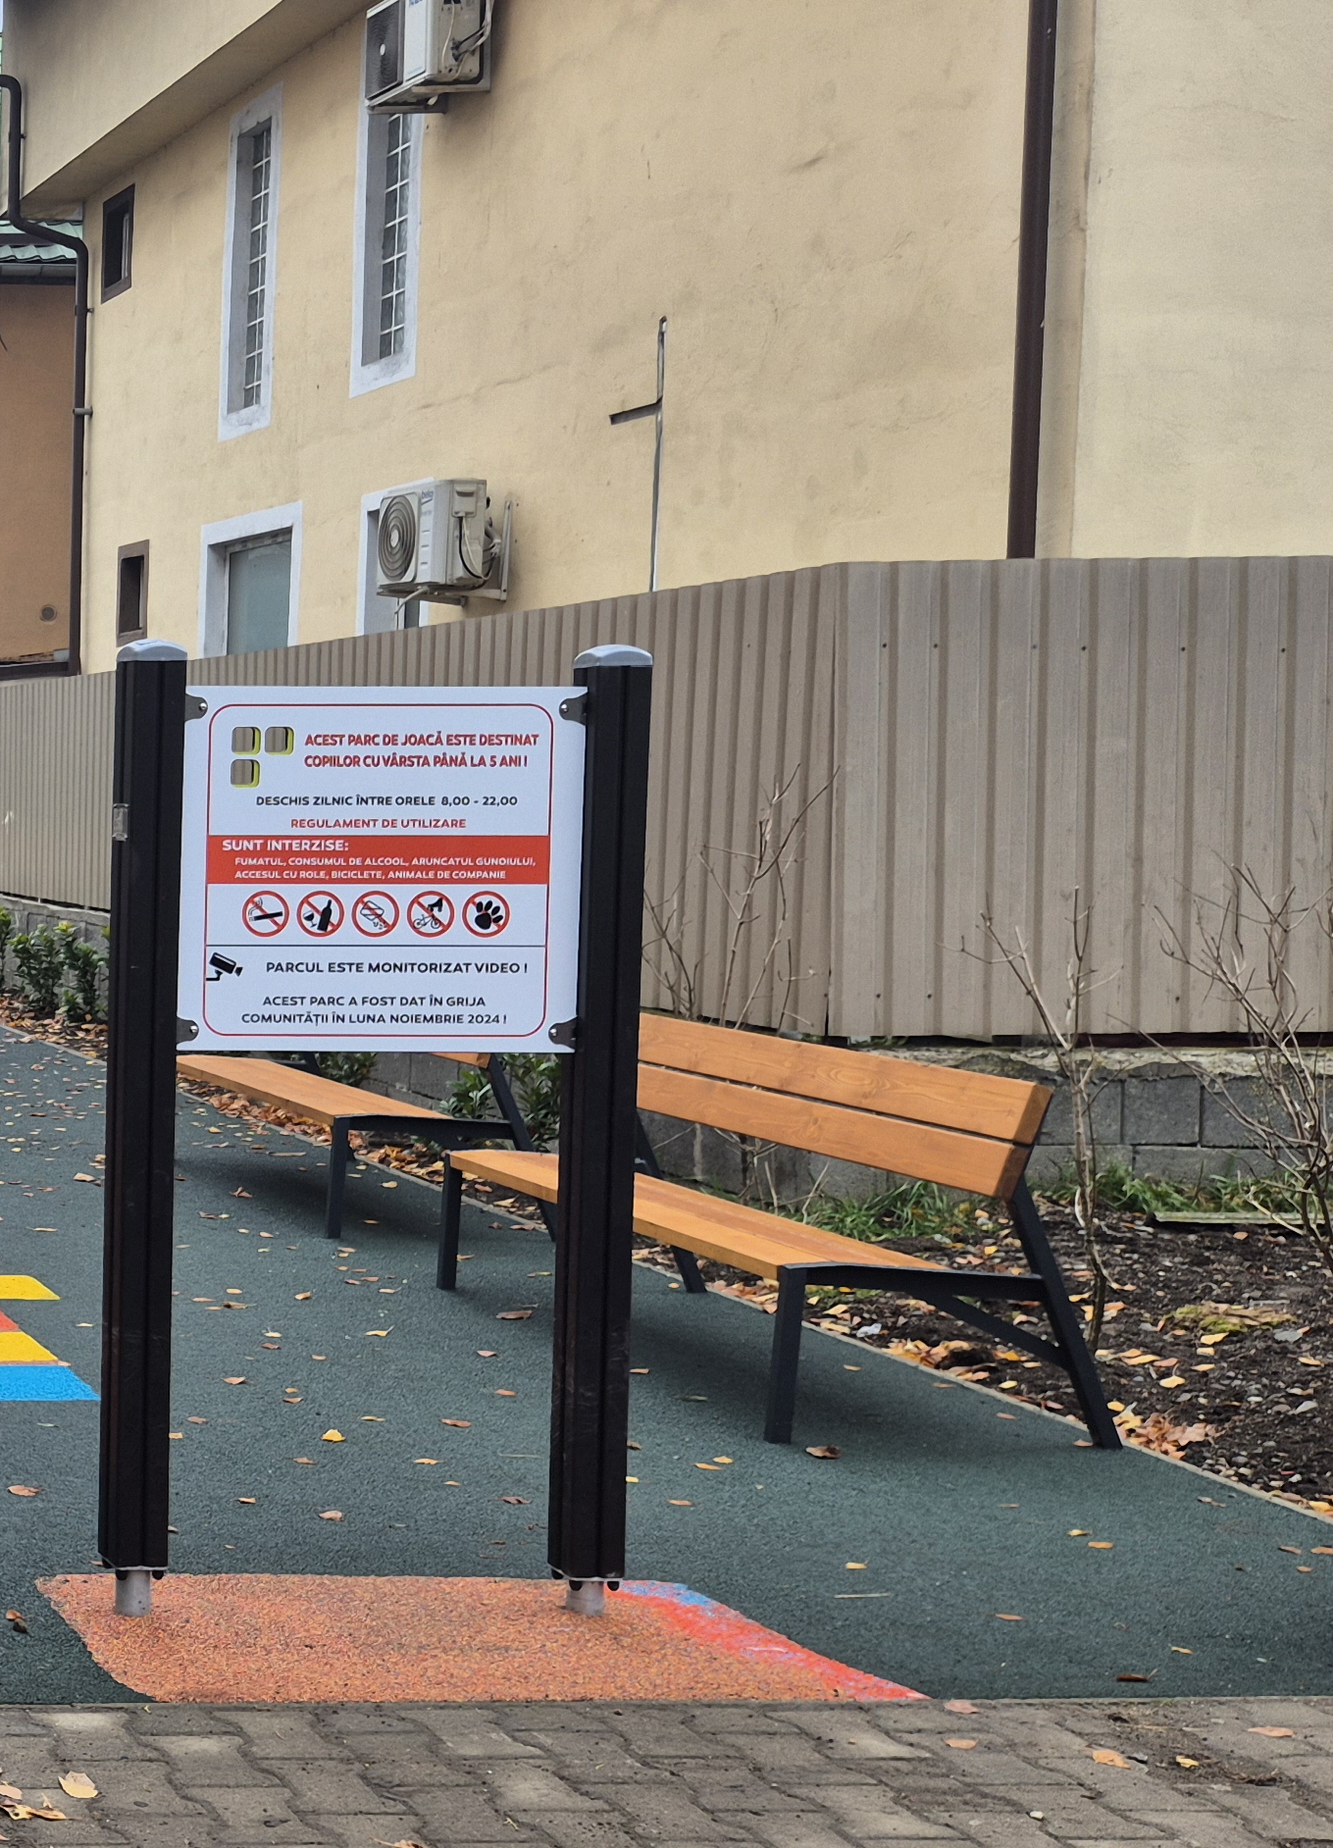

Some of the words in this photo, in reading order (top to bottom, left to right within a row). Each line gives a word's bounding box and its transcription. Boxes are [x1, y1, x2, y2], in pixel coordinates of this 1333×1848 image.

[304, 733, 346, 746] ACEST
[347, 733, 381, 746] PARC
[382, 733, 399, 746] DE
[400, 730, 444, 746] JOACĂ
[445, 733, 477, 746] ESTE
[479, 733, 540, 746] DESTINAT
[304, 754, 361, 767] COPIILOR
[362, 754, 380, 767] CU
[382, 751, 431, 767] VÂRSTA
[432, 751, 468, 767] PÂNĂ
[470, 754, 487, 767] LA
[489, 754, 497, 767] 5
[499, 754, 522, 767] ANI
[256, 796, 310, 806] DESCHIS
[312, 796, 353, 806] ZILNIC
[355, 793, 393, 806] ÎNTRE
[394, 796, 436, 806] ORELE
[440, 796, 471, 807] 8,00
[482, 796, 518, 807] 22,00
[290, 818, 379, 828] REGULAMENT
[381, 818, 398, 828] DE
[400, 818, 467, 828] UTILIZARE
[222, 839, 265, 851] SUNT
[267, 839, 349, 851] INTERZISE:
[234, 857, 287, 867] FUMATUL,
[288, 857, 347, 866] CONSUMUL
[348, 857, 362, 866] DE
[364, 857, 410, 867] ALCOOL,
[411, 857, 474, 866] ARUNCATUL
[475, 857, 536, 867] GUNOIULUI,
[234, 870, 281, 879] ACCESUL
[282, 870, 298, 879] CU
[299, 870, 329, 880] ROLE,
[331, 870, 386, 880] BICICLETE,
[387, 870, 435, 879] ANIMALE
[436, 870, 452, 879] DE
[452, 870, 506, 879] COMPANIE
[266, 962, 324, 973] PARCUL
[327, 962, 365, 973] ESTE
[367, 962, 473, 974] MONITORIZAT
[474, 962, 521, 974] VIDEO
[262, 996, 307, 1006] ACEST
[309, 996, 345, 1006] PARC
[348, 996, 358, 1006] A
[361, 996, 397, 1006] FOST
[399, 996, 427, 1007] DAT
[429, 993, 443, 1007] ÎN
[445, 996, 486, 1007] GRIJA
[331, 1010, 346, 1024] ÎN
[348, 1013, 386, 1024] LUNA
[389, 1013, 464, 1024] NOIEMBRIE
[467, 1013, 500, 1024] 2024
